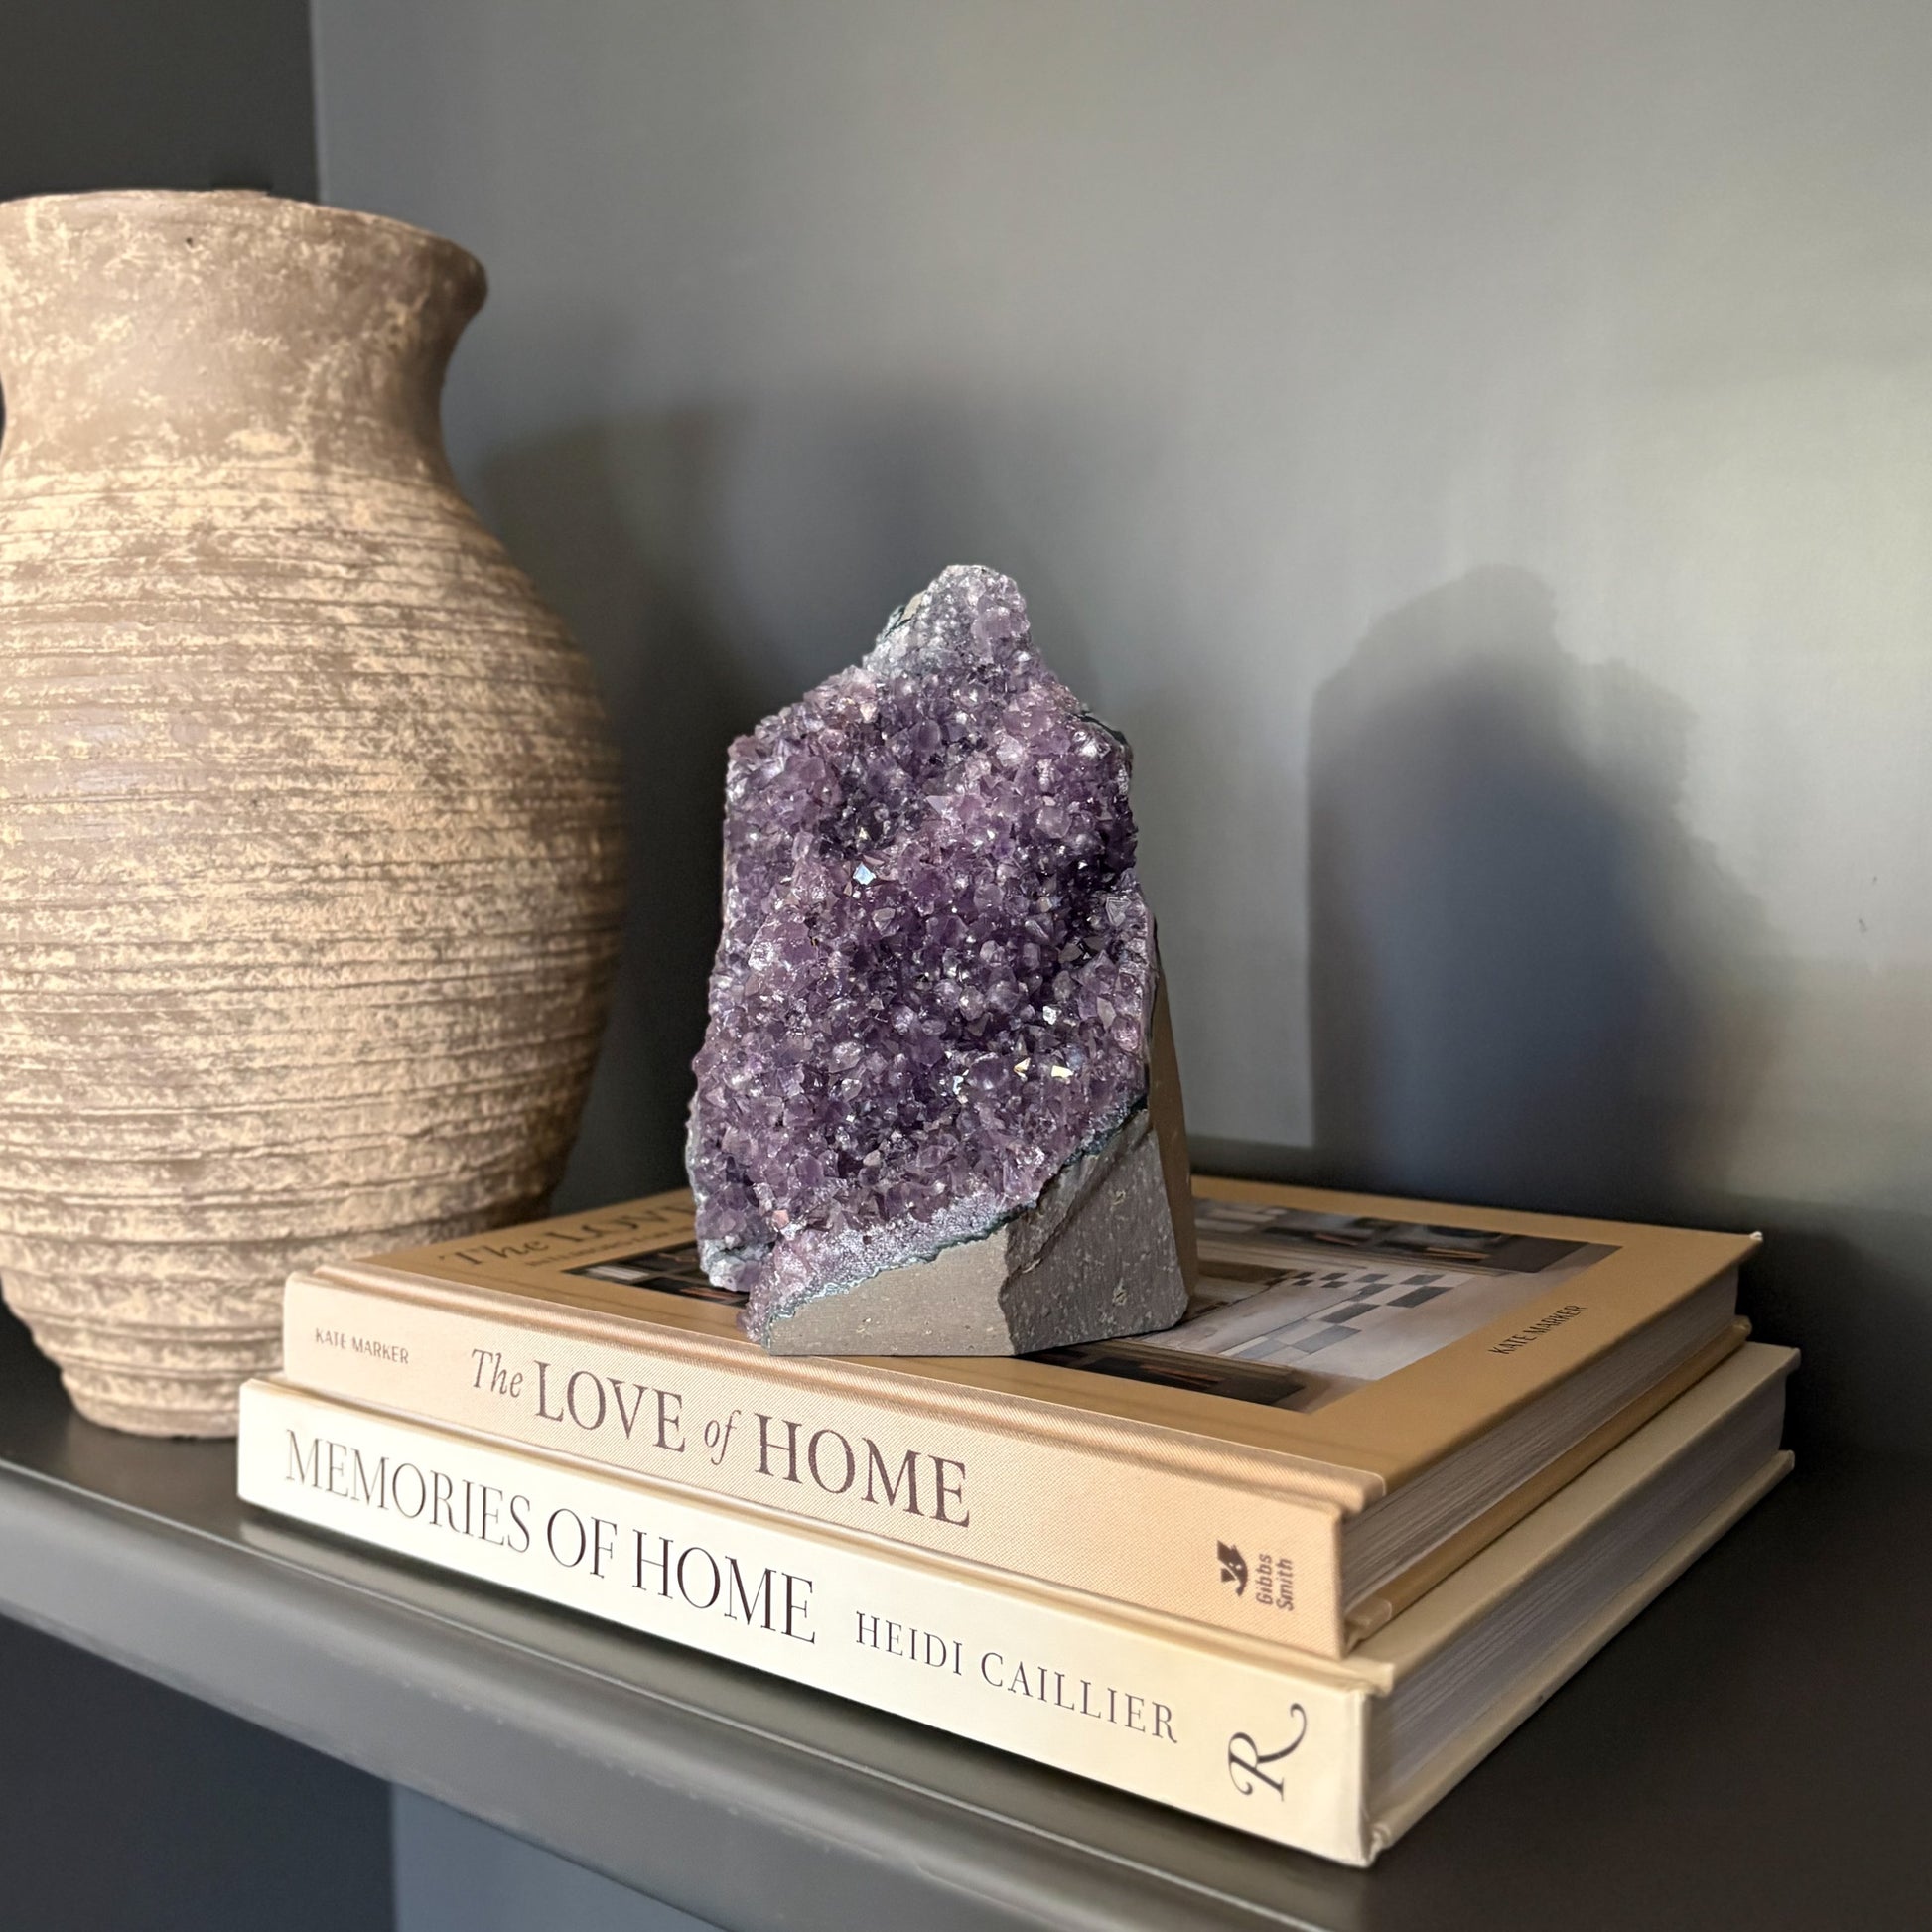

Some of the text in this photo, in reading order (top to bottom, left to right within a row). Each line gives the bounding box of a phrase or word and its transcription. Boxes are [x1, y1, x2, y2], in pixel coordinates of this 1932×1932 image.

[315, 1327, 409, 1365] KATE MARKER
[1488, 1304, 1588, 1355] KATE MARKER
[471, 1348, 971, 1529] The LOVE of HOME
[284, 1428, 817, 1645] MEMORIES OF HOME
[1255, 1553, 1274, 1606] Gibbs
[1275, 1557, 1295, 1612] Smith
[855, 1610, 1178, 1744] HEIDI CAILLIER
